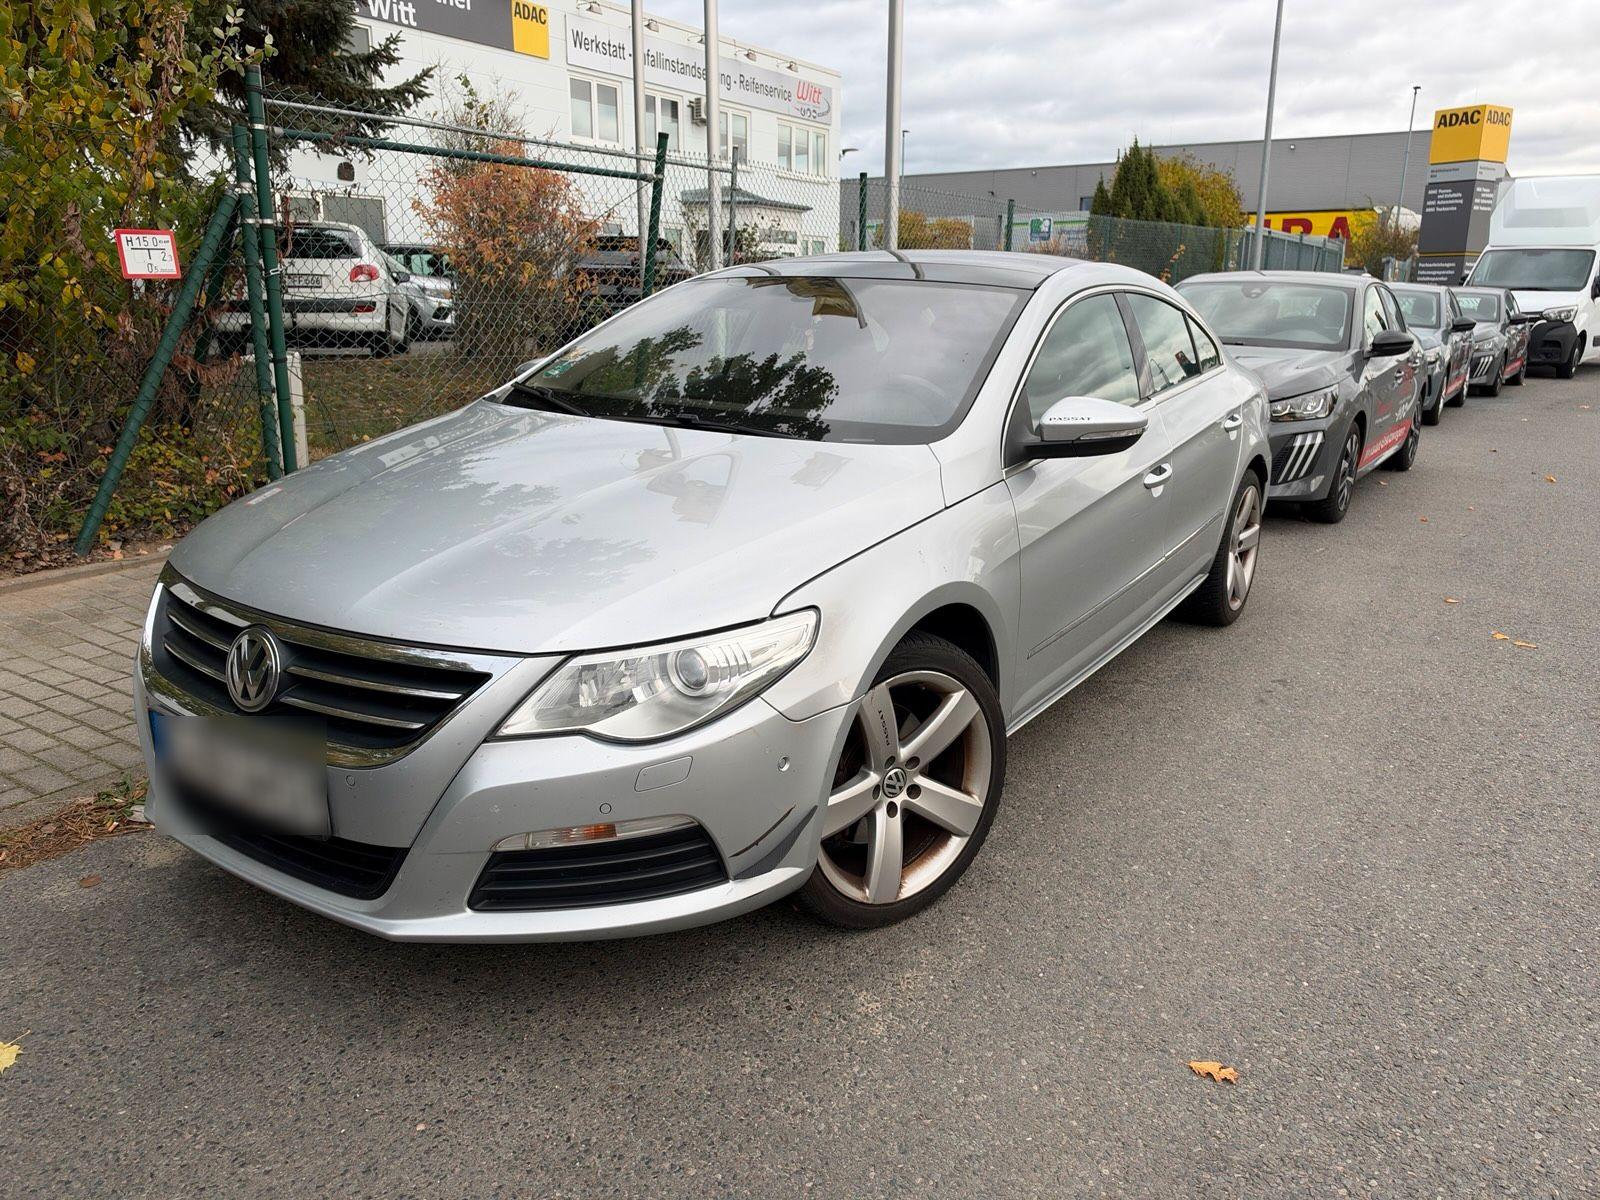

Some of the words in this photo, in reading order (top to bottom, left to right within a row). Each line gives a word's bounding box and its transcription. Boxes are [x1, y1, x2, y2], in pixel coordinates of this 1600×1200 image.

[514, 2, 547, 25] ADAC
[572, 29, 626, 61] Werkstatt
[644, 49, 732, 91] fallinstandseng
[739, 73, 792, 102] Reifenservice
[797, 80, 822, 105] Witt
[1437, 110, 1482, 129] ADAC
[1487, 110, 1511, 127] ADAC
[878, 709, 890, 747] PASSAT
